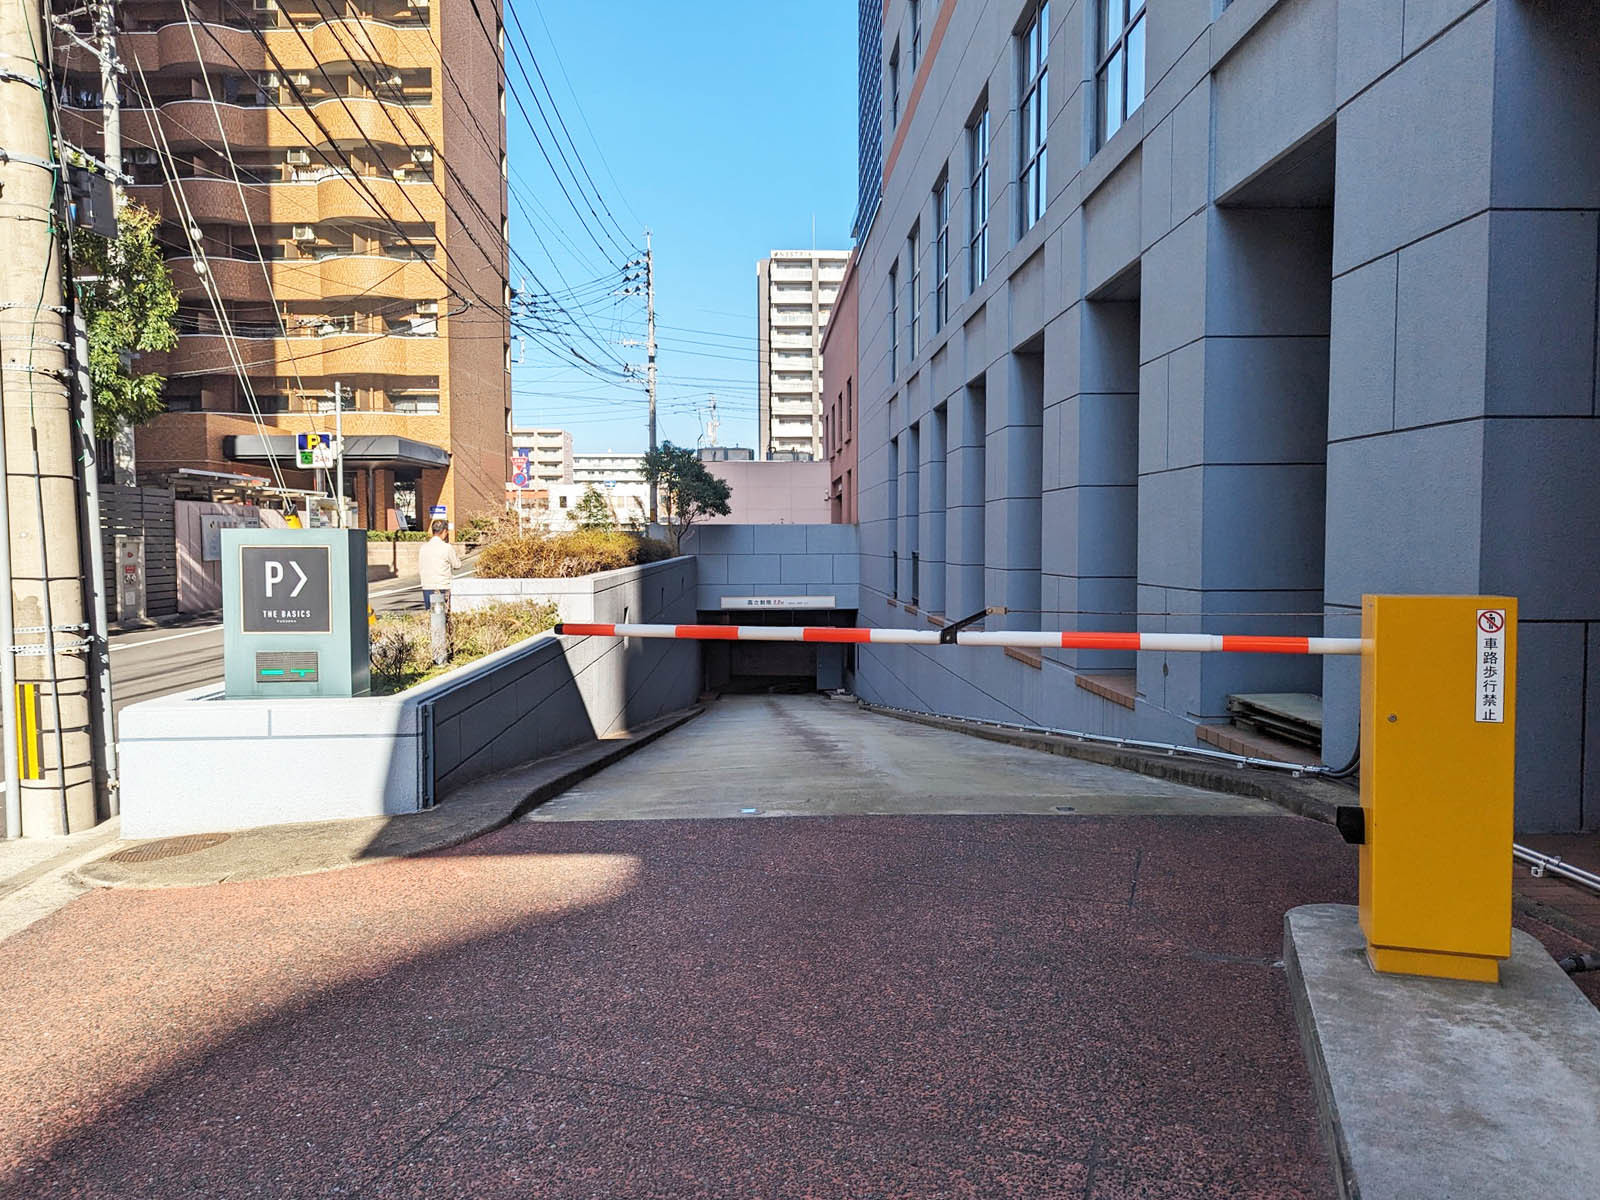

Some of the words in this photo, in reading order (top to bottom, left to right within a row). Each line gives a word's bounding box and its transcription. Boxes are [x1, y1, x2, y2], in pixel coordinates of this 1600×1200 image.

[307, 434, 321, 450] P
[264, 560, 284, 598] P
[262, 610, 278, 618] THE
[281, 610, 311, 618] BASICS
[1482, 637, 1498, 721] 車路歩行禁止
